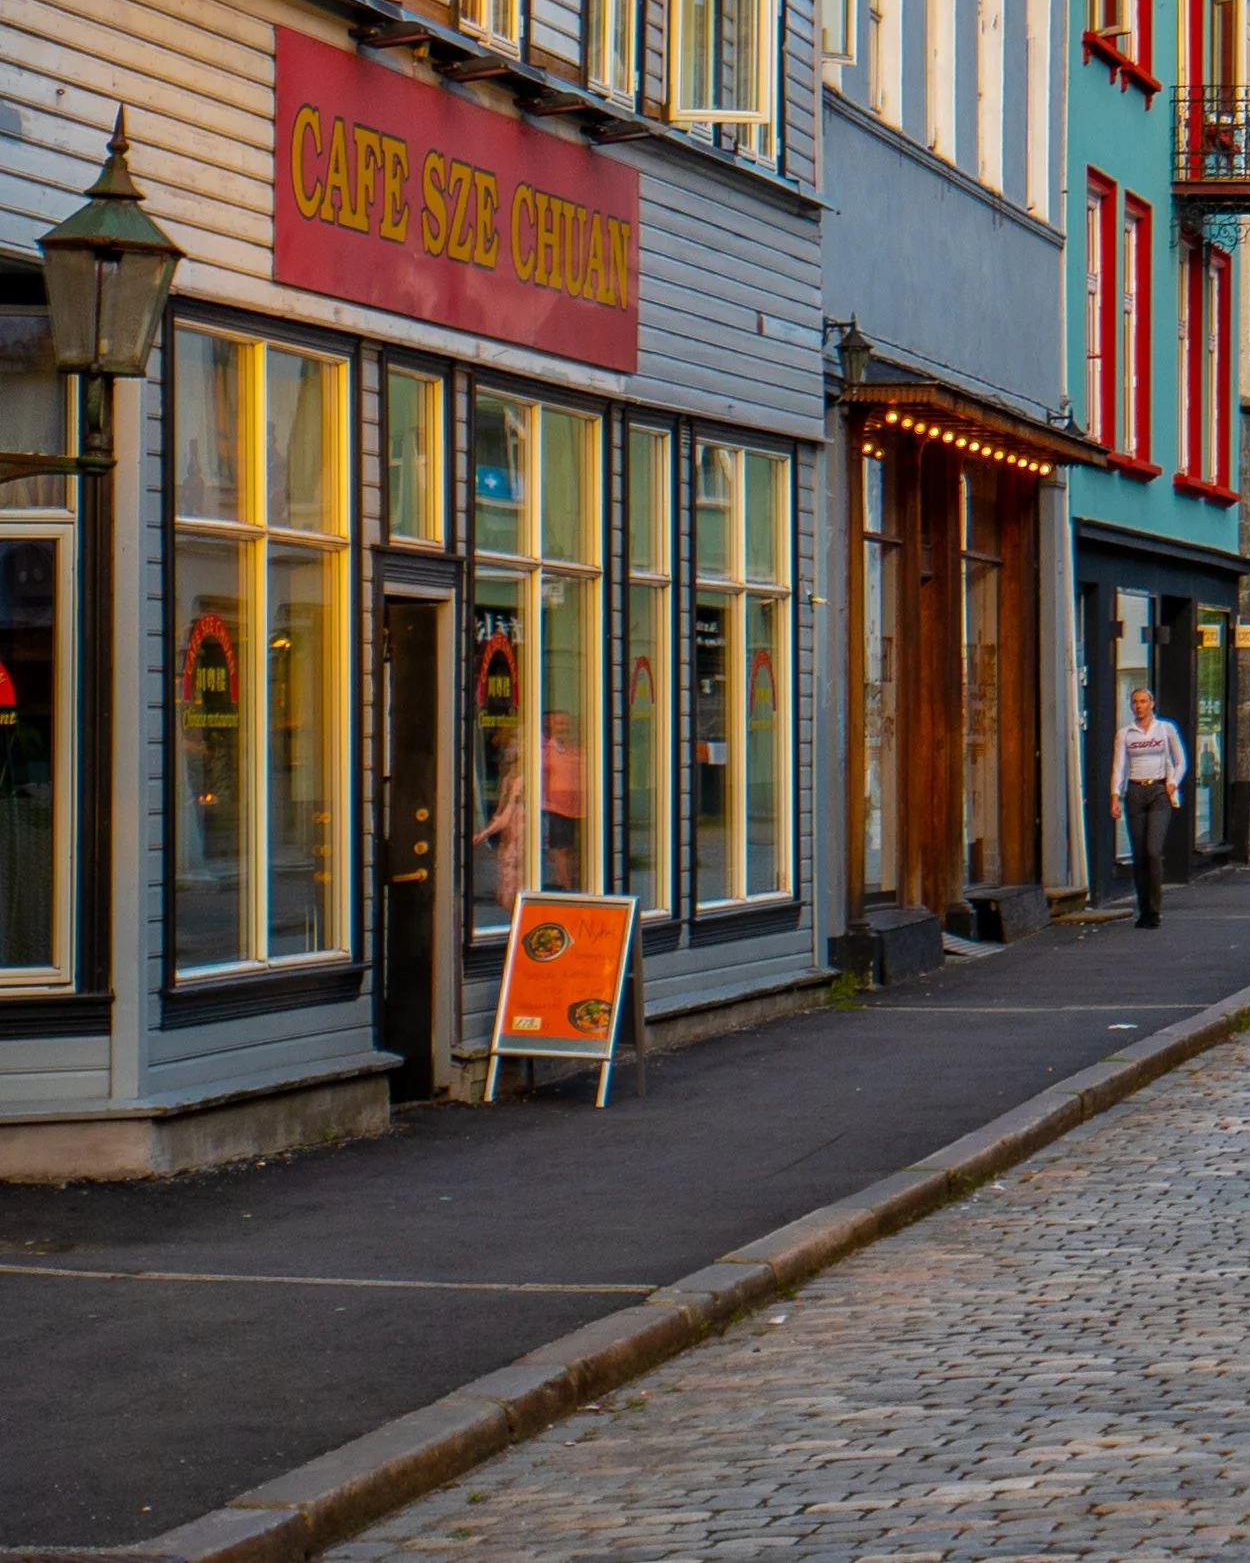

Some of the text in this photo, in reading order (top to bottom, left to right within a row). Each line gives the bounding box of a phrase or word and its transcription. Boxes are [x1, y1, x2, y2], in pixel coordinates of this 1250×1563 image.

[291, 104, 631, 311] CAFE SZE CHUAN
